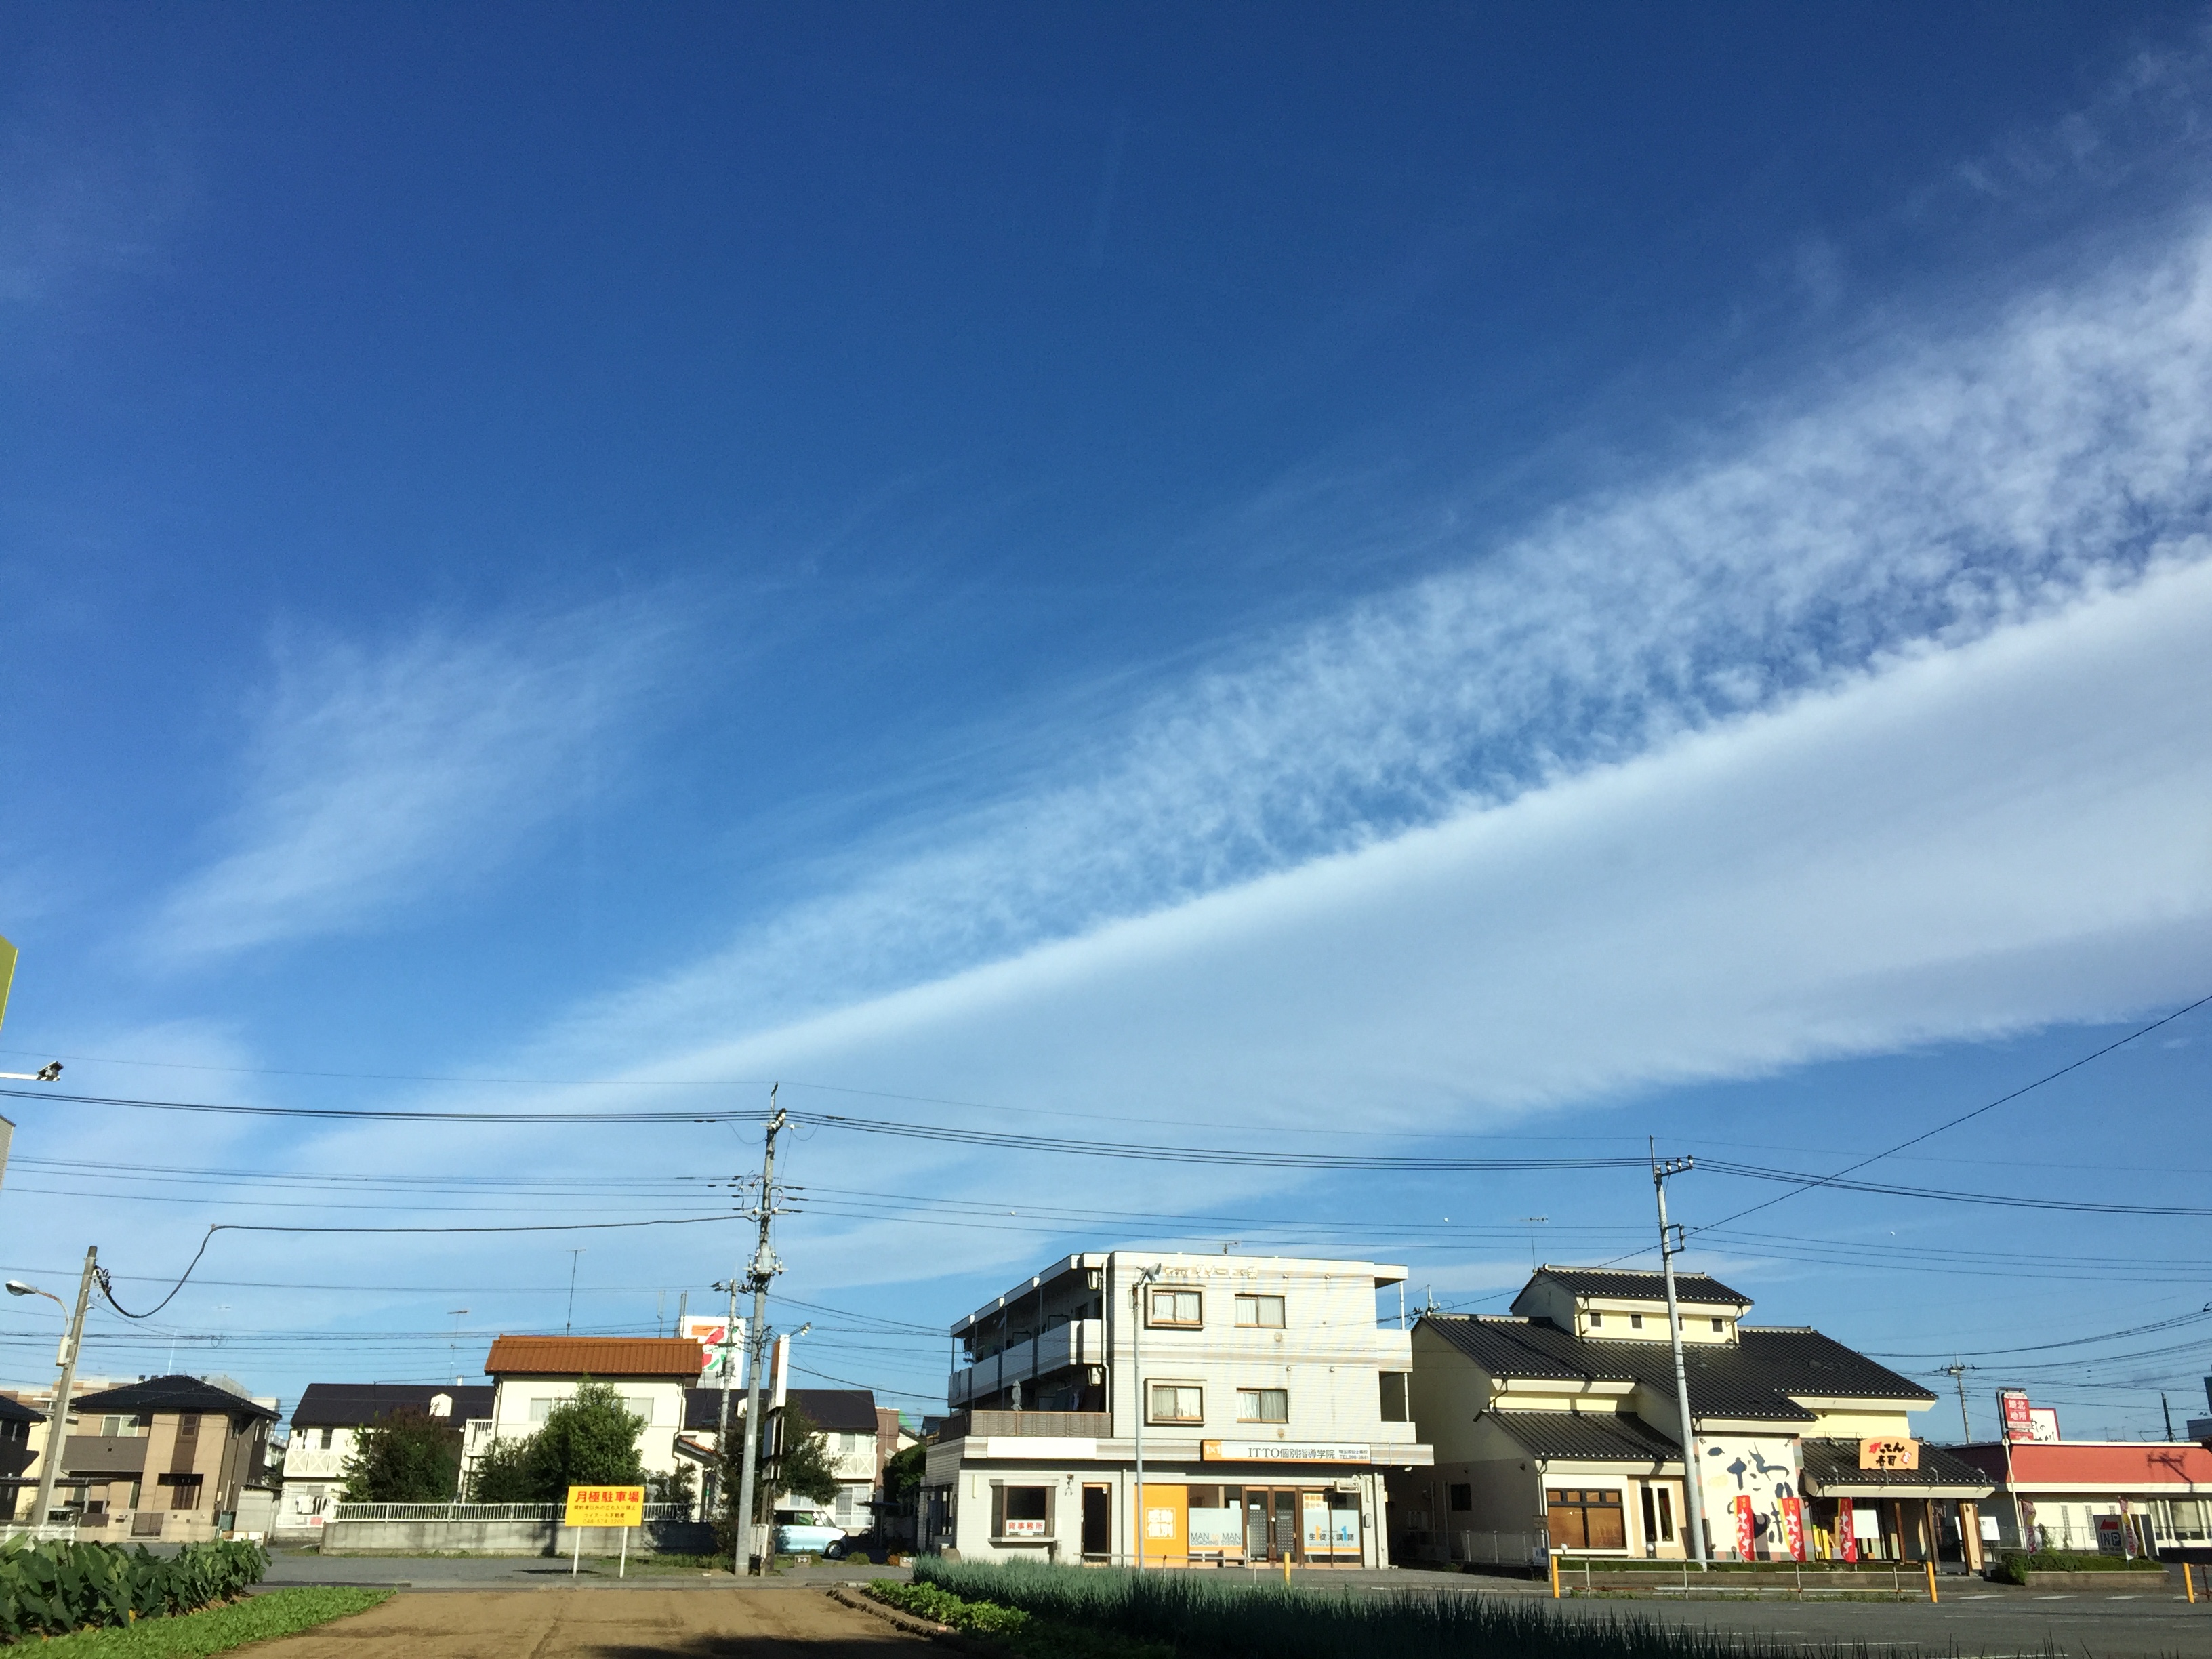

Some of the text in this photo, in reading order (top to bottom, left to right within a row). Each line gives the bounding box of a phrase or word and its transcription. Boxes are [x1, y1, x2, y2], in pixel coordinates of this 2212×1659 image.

[1869, 1441, 1906, 1454] がってん
[1248, 1448, 1336, 1460] ITTO個別指導学院
[1876, 1455, 1897, 1466] 寿司
[575, 1491, 640, 1503] 月極駐車場
[1008, 1521, 1044, 1530] 貸事務所
[1191, 1532, 1210, 1540] MAN
[1222, 1532, 1241, 1540] MAN
